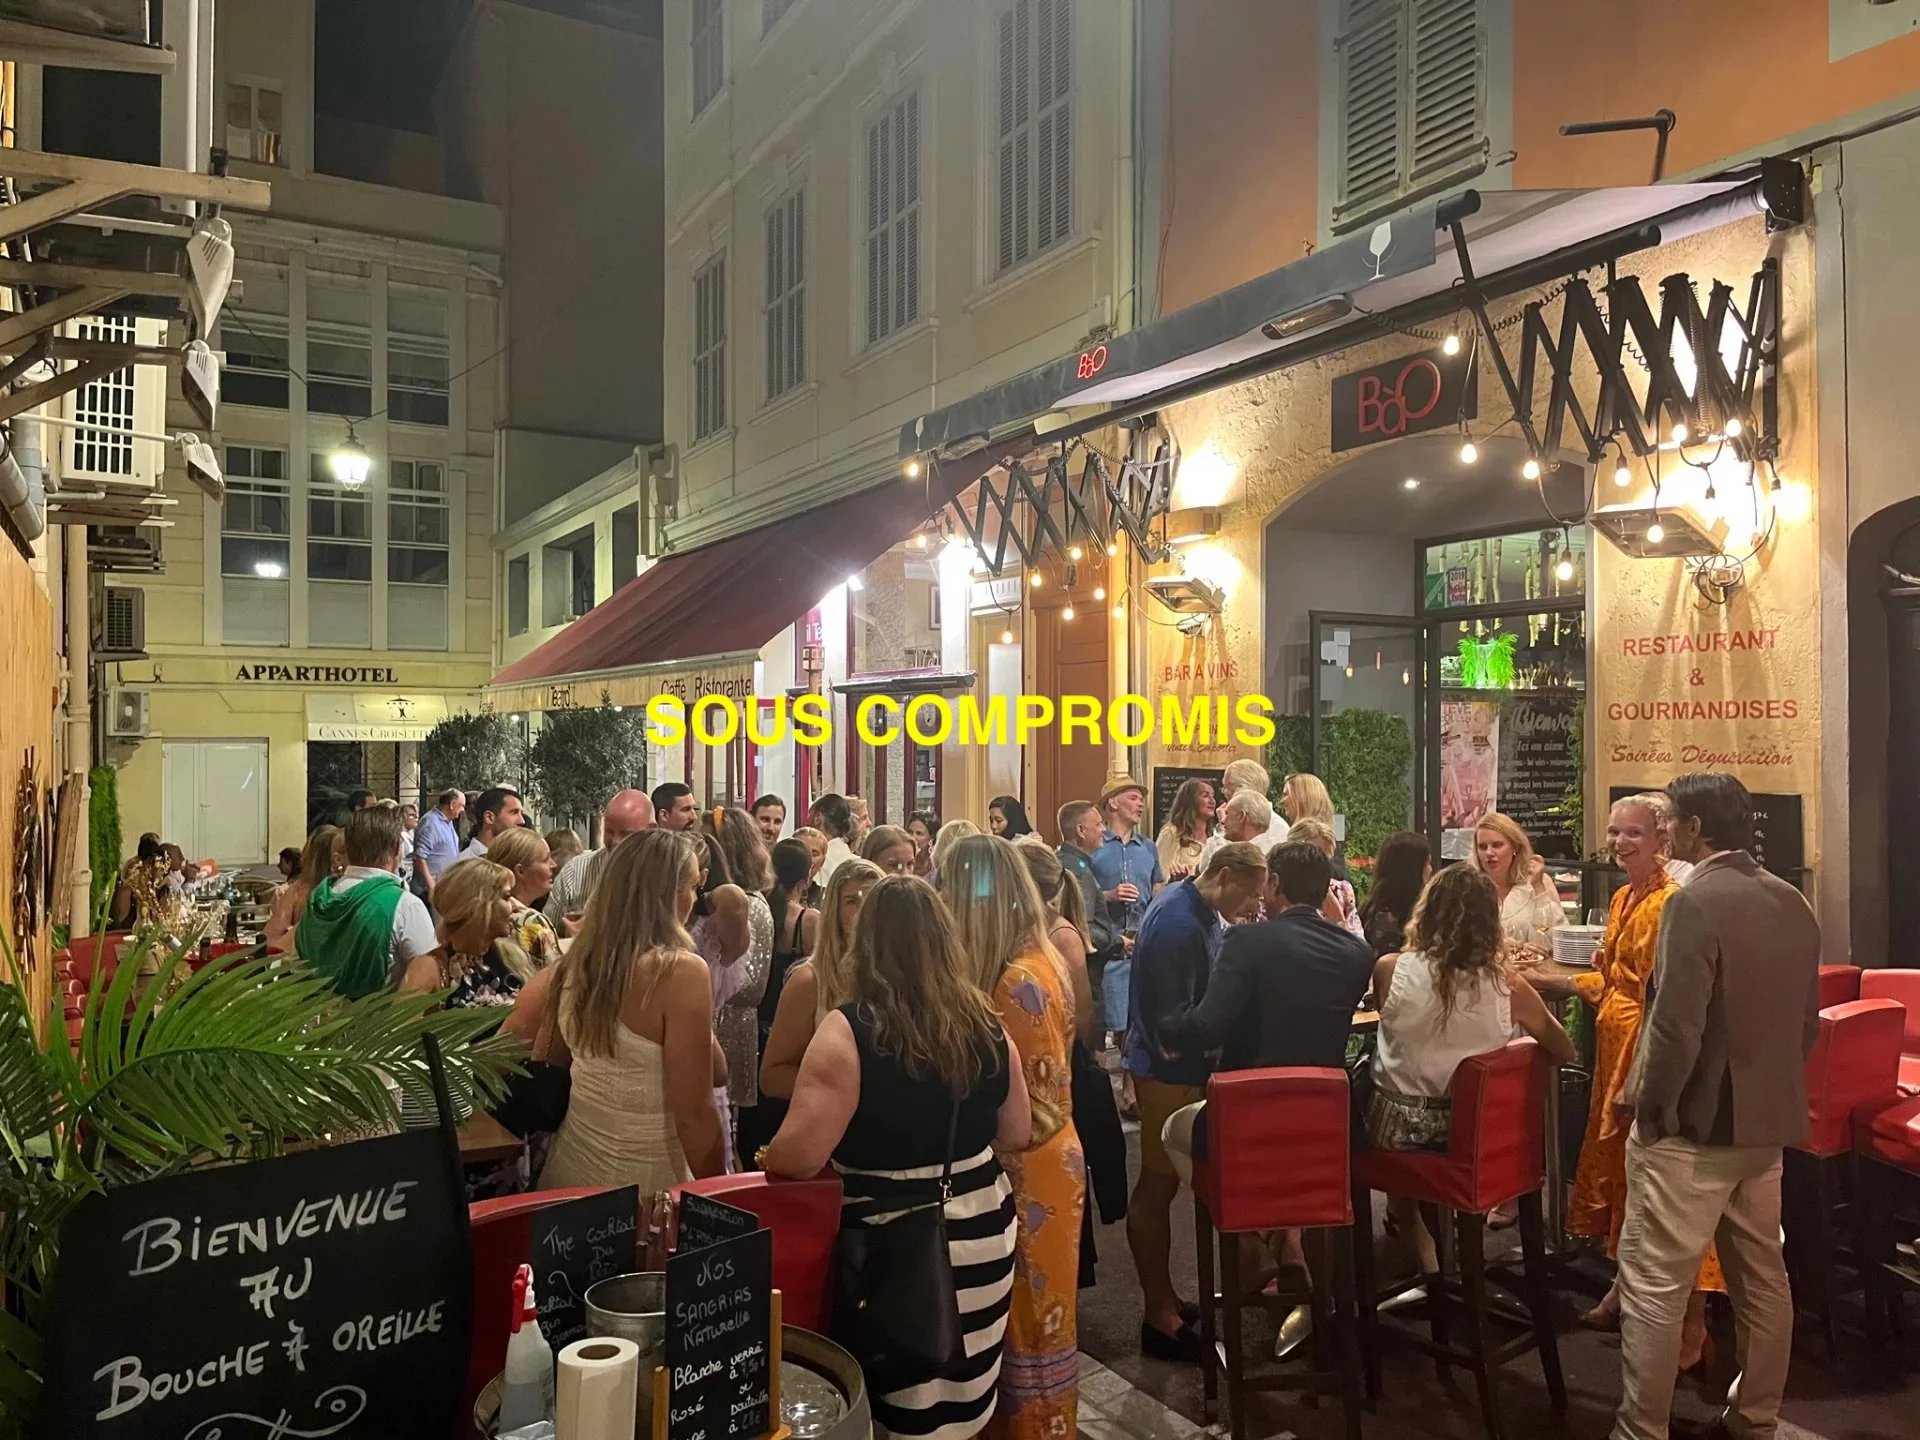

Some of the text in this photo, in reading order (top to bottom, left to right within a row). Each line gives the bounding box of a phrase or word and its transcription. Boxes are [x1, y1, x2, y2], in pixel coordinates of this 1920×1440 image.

[1623, 630, 1779, 656] RESTAURANT
[235, 664, 399, 683] APPARTHOTEL
[1165, 665, 1191, 682] BAR
[1208, 660, 1238, 679] VINS
[1689, 667, 1705, 686] &
[694, 675, 752, 700] Ristorante
[1608, 699, 1798, 721] GOURMANDISES
[319, 725, 429, 739] CANNES CROISETT
[1611, 743, 1673, 762] Soirées
[542, 1225, 575, 1261] The
[240, 1257, 313, 1318] AU
[93, 1341, 271, 1421] BOUCHE
[670, 1395, 705, 1426] Rosé
